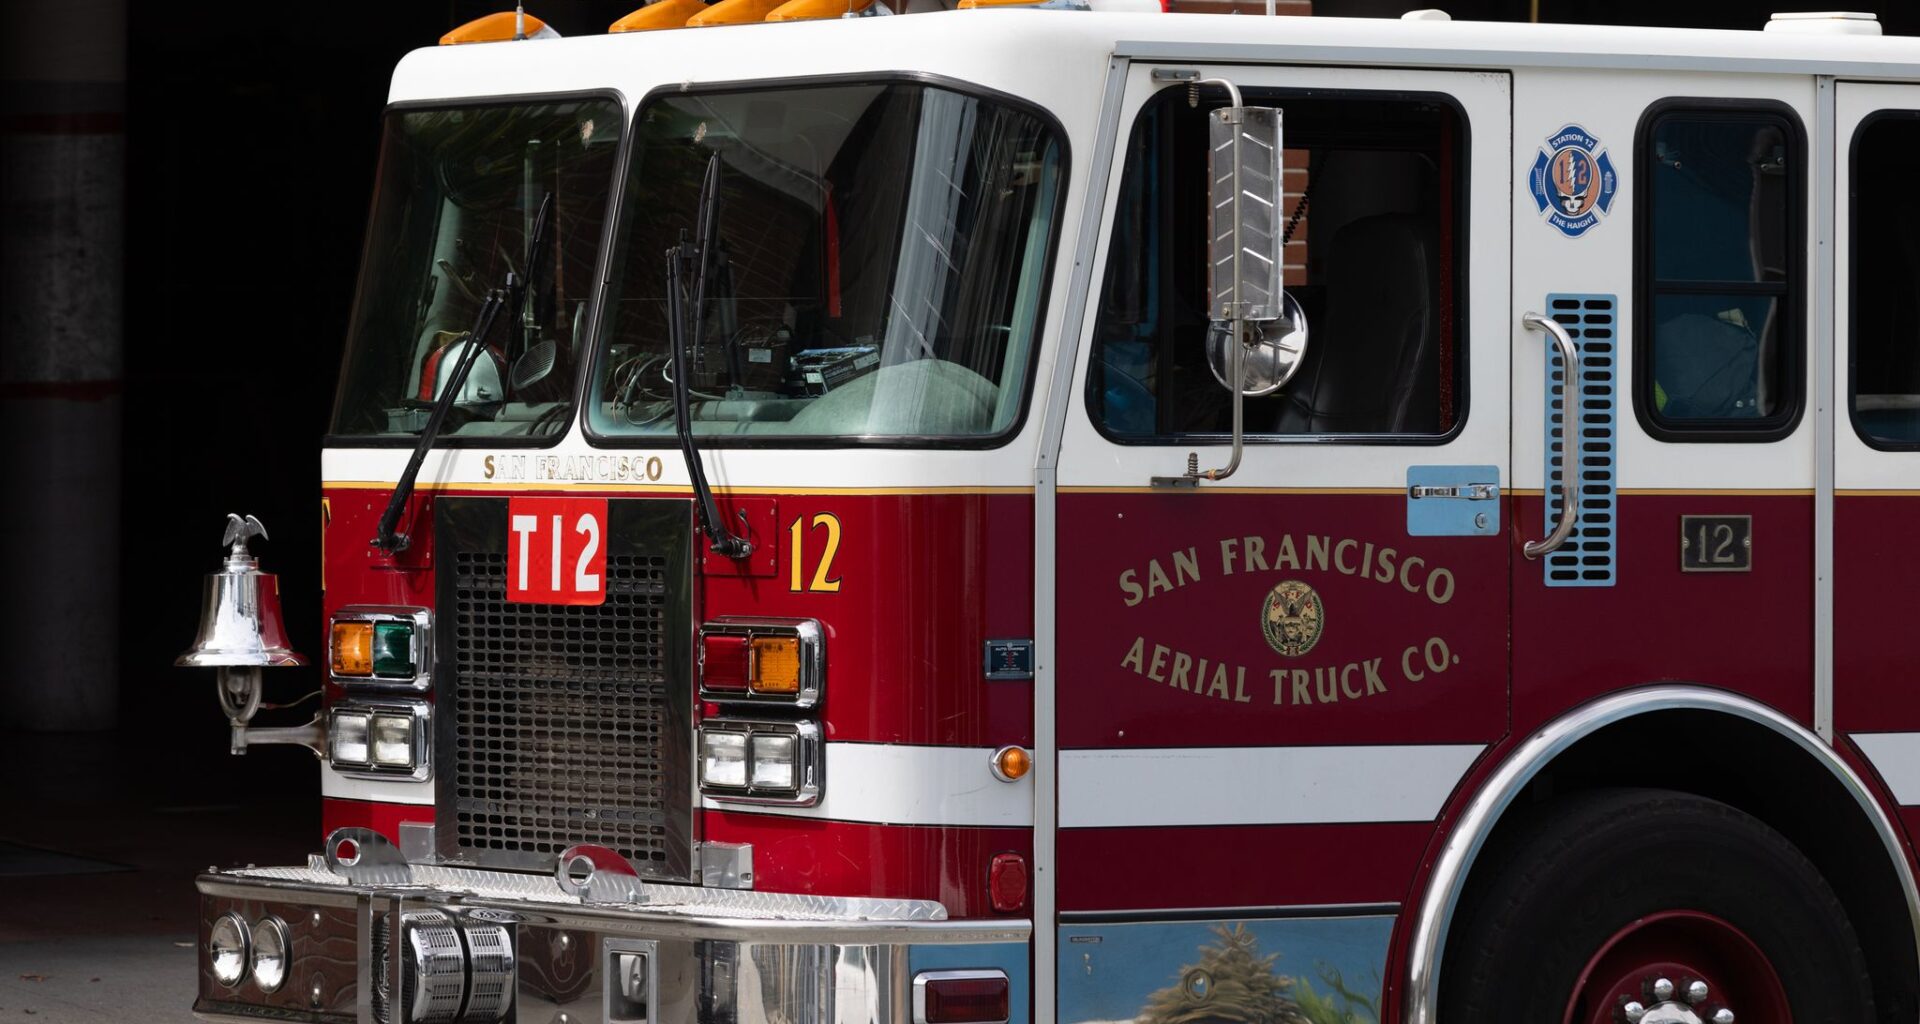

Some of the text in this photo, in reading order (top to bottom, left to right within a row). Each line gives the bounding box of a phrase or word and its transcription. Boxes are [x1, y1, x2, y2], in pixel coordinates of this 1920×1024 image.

[1552, 134, 1594, 148] STATION 12
[1552, 215, 1594, 229] THE HAIGHT
[484, 454, 663, 481] SAN FRANCISCO
[787, 510, 842, 593] 12
[1697, 524, 1735, 563] 12
[1118, 533, 1455, 607] SAN FRANCISCO
[1120, 636, 1460, 705] AERIAL TRUCK CO.
